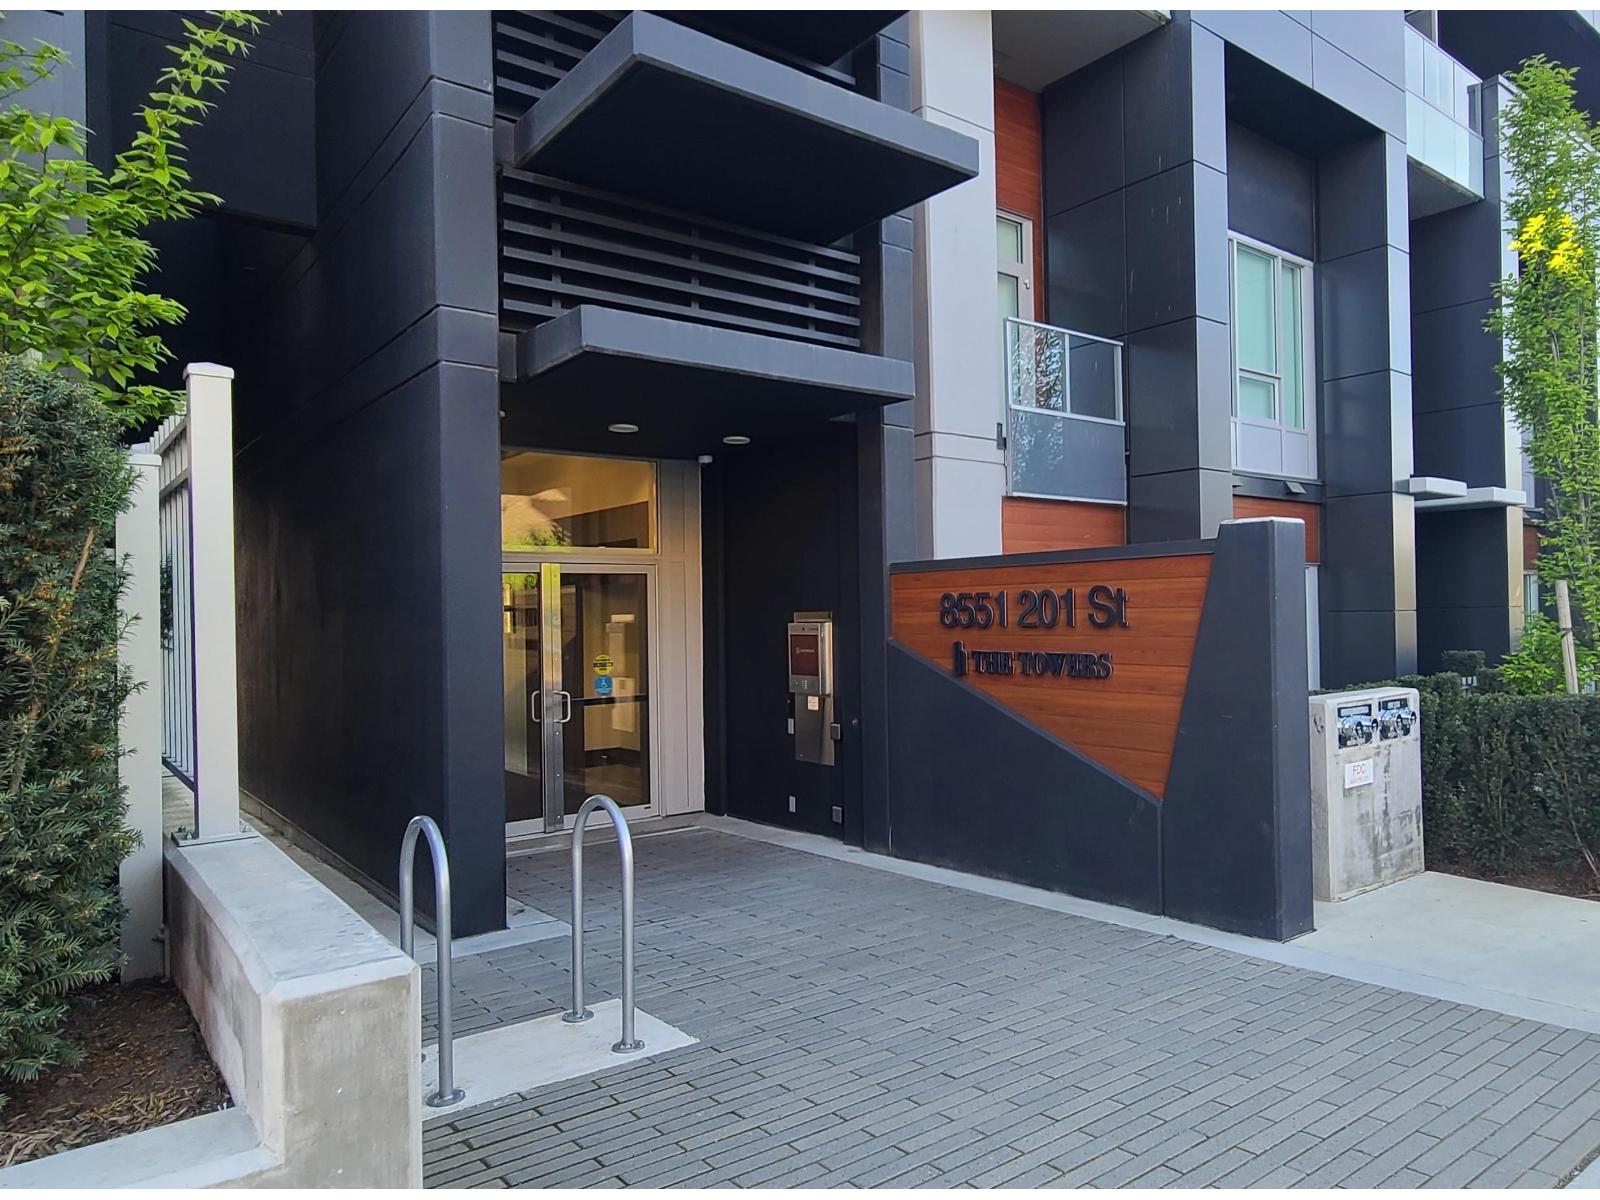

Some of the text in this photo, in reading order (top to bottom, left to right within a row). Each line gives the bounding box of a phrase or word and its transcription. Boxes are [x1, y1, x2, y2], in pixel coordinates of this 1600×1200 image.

[940, 584, 1129, 629] 8551 201 St
[971, 649, 1015, 675] THE
[1018, 650, 1113, 679] TOWERS
